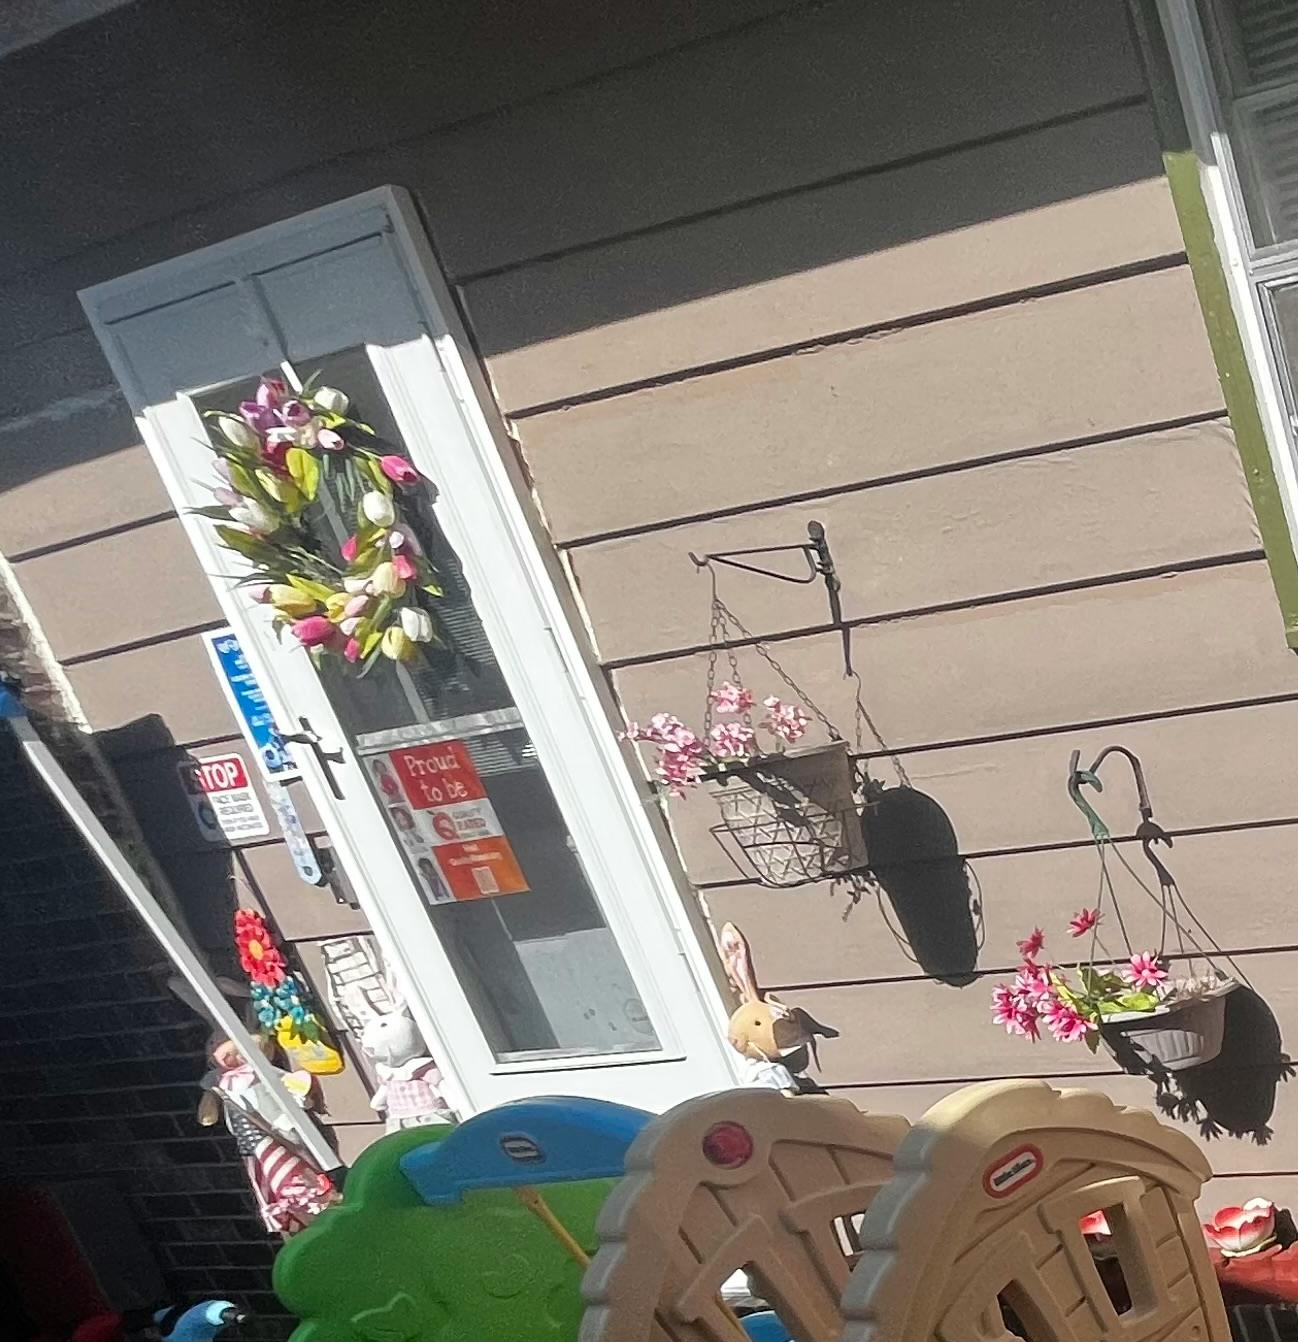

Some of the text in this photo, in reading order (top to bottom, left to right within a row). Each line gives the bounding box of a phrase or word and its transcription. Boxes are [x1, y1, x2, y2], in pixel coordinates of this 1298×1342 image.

[403, 746, 461, 777] Proud
[420, 777, 469, 803] to be
